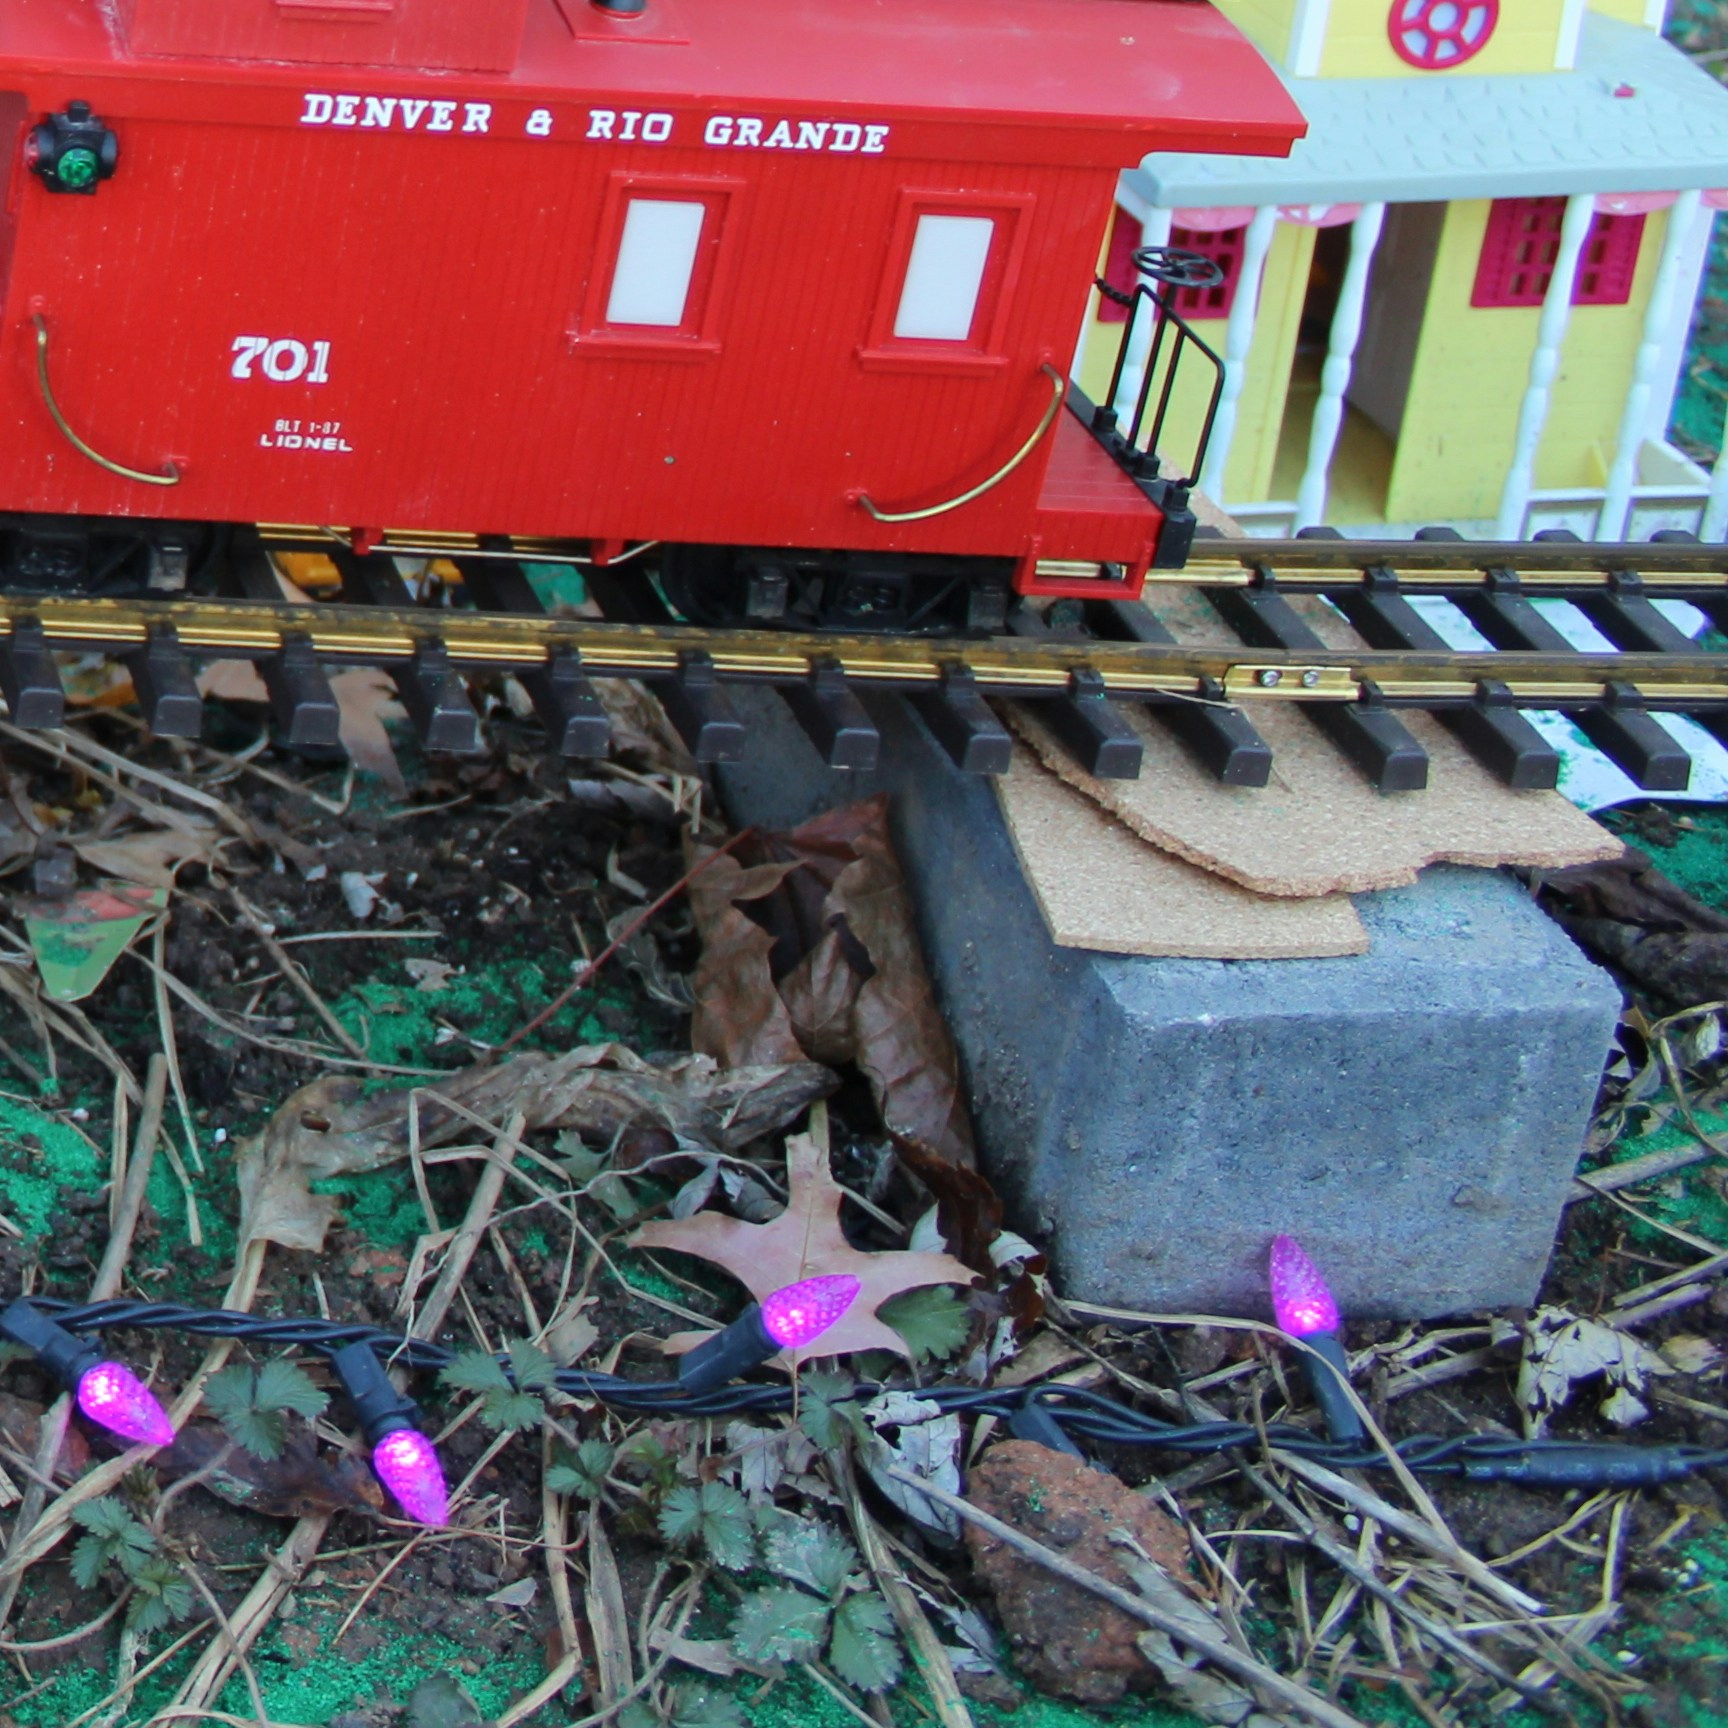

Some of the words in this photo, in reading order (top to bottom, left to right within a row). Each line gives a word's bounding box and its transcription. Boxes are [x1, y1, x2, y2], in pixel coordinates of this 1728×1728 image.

[300, 93, 492, 134] DENVER
[525, 108, 553, 136] &
[586, 109, 674, 142] RIO
[704, 116, 890, 153] GRANDE
[231, 335, 332, 383] 701
[275, 419, 301, 432] BLT
[259, 433, 353, 452] LIONEL
